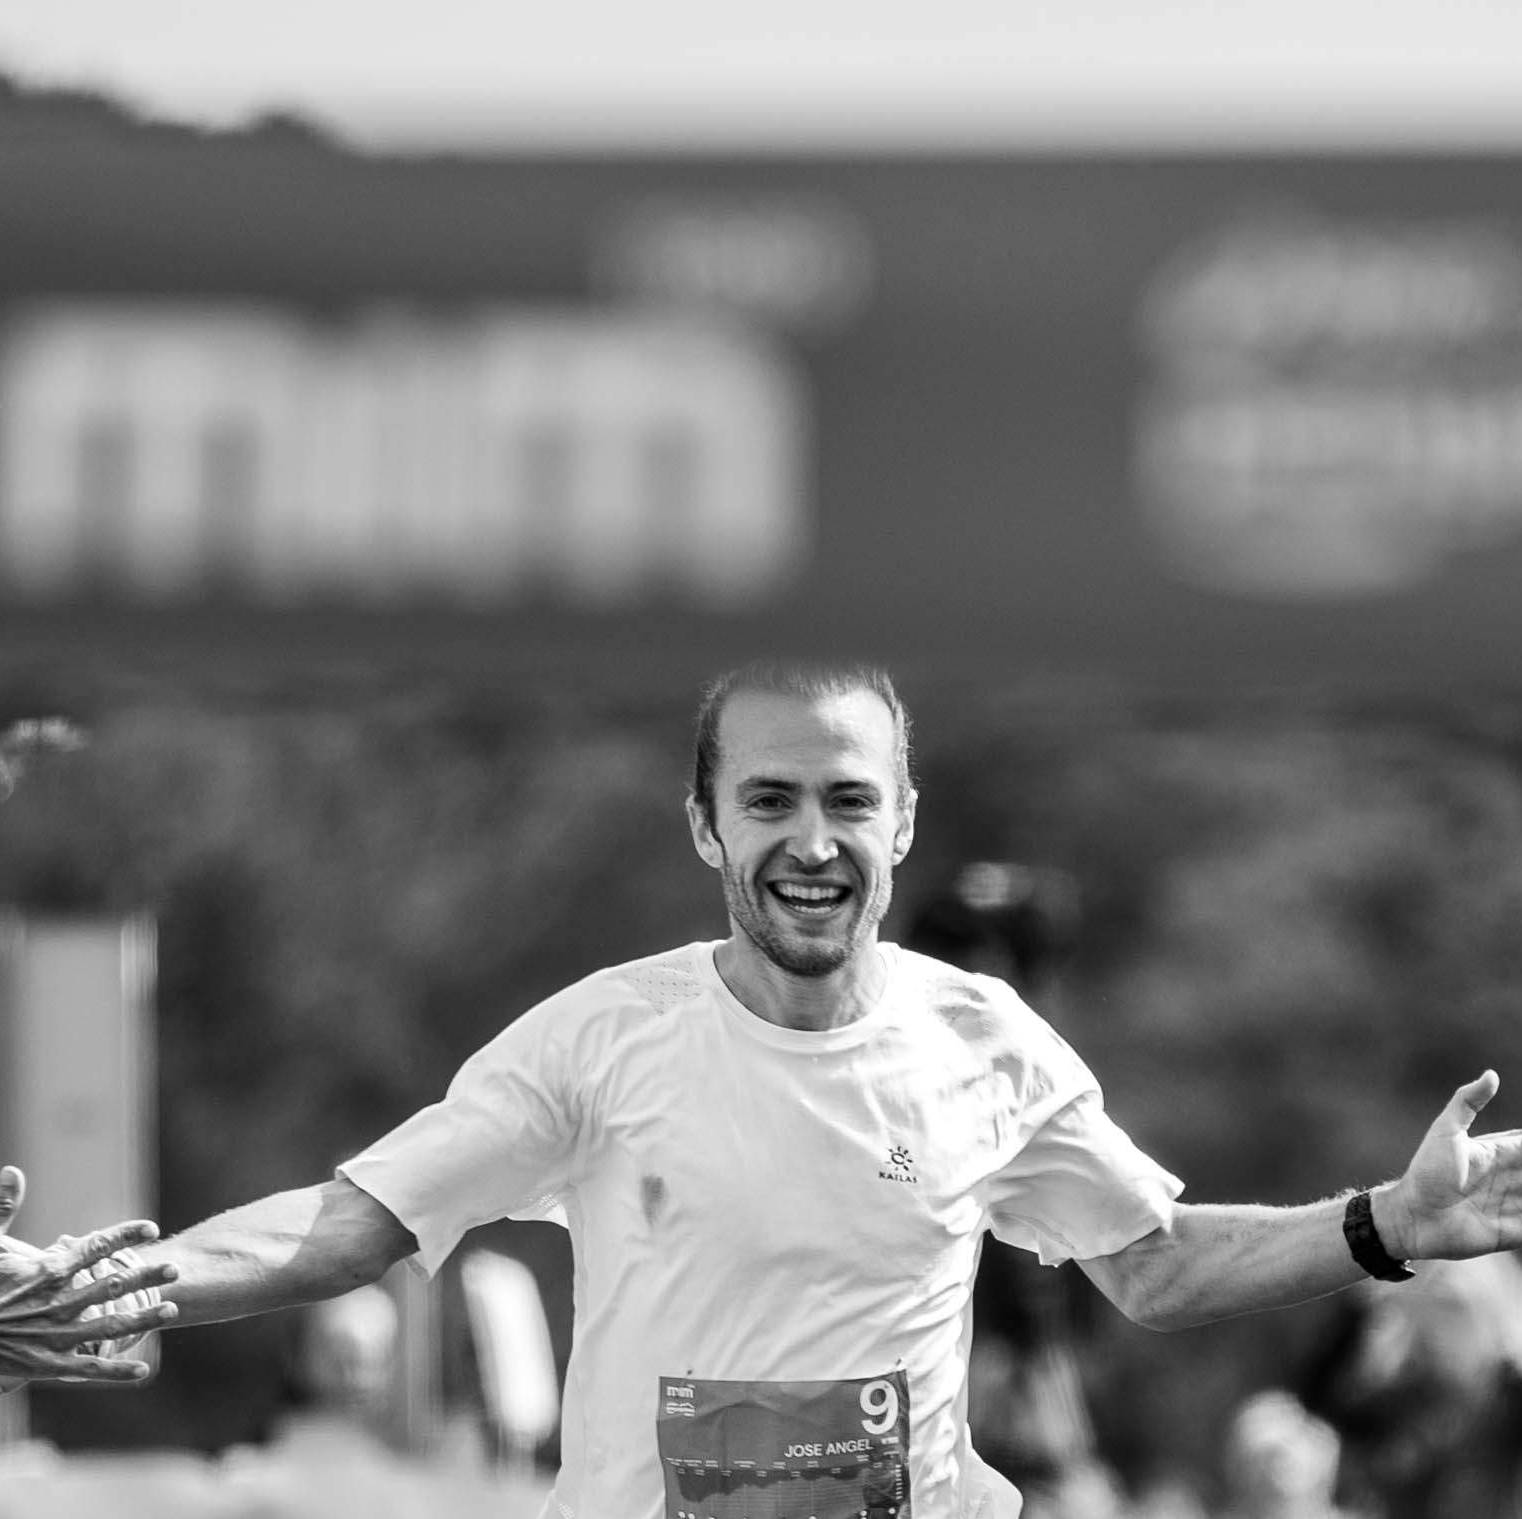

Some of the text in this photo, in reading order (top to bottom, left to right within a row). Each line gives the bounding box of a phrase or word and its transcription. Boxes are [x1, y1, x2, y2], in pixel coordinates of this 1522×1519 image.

[878, 1171, 918, 1184] KAILAS
[859, 1380, 899, 1434] 9
[784, 1444, 823, 1457] JOSE
[825, 1438, 875, 1455] ANGEL
